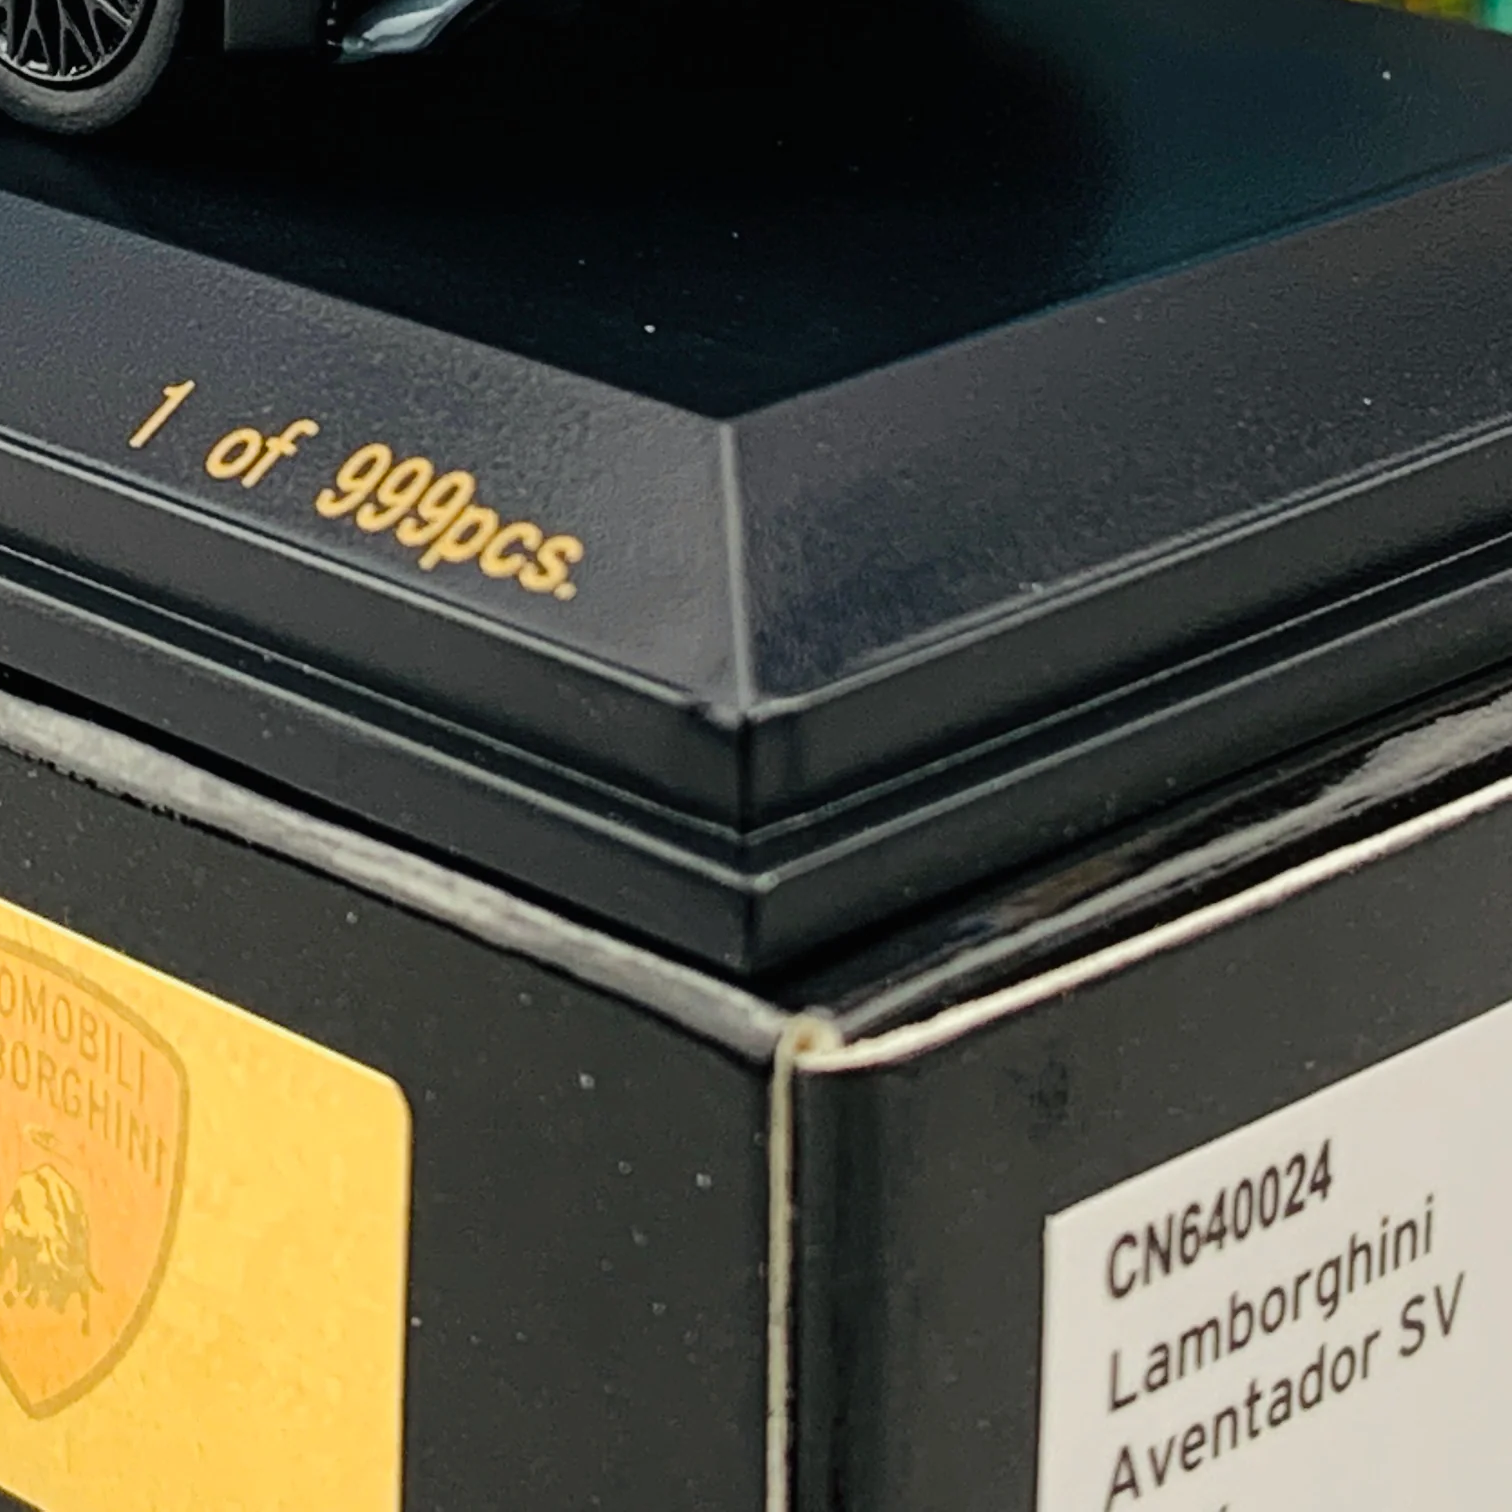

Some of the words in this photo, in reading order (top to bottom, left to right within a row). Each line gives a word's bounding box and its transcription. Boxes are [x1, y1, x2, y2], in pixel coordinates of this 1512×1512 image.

[128, 379, 195, 449] 1
[205, 418, 320, 488] of
[315, 442, 584, 601] 999pcs.
[1105, 1138, 1333, 1301] CN640024
[1108, 1192, 1436, 1413] Lamborghini
[1104, 1328, 1381, 1512] Aventador
[1397, 1271, 1466, 1359] SV
